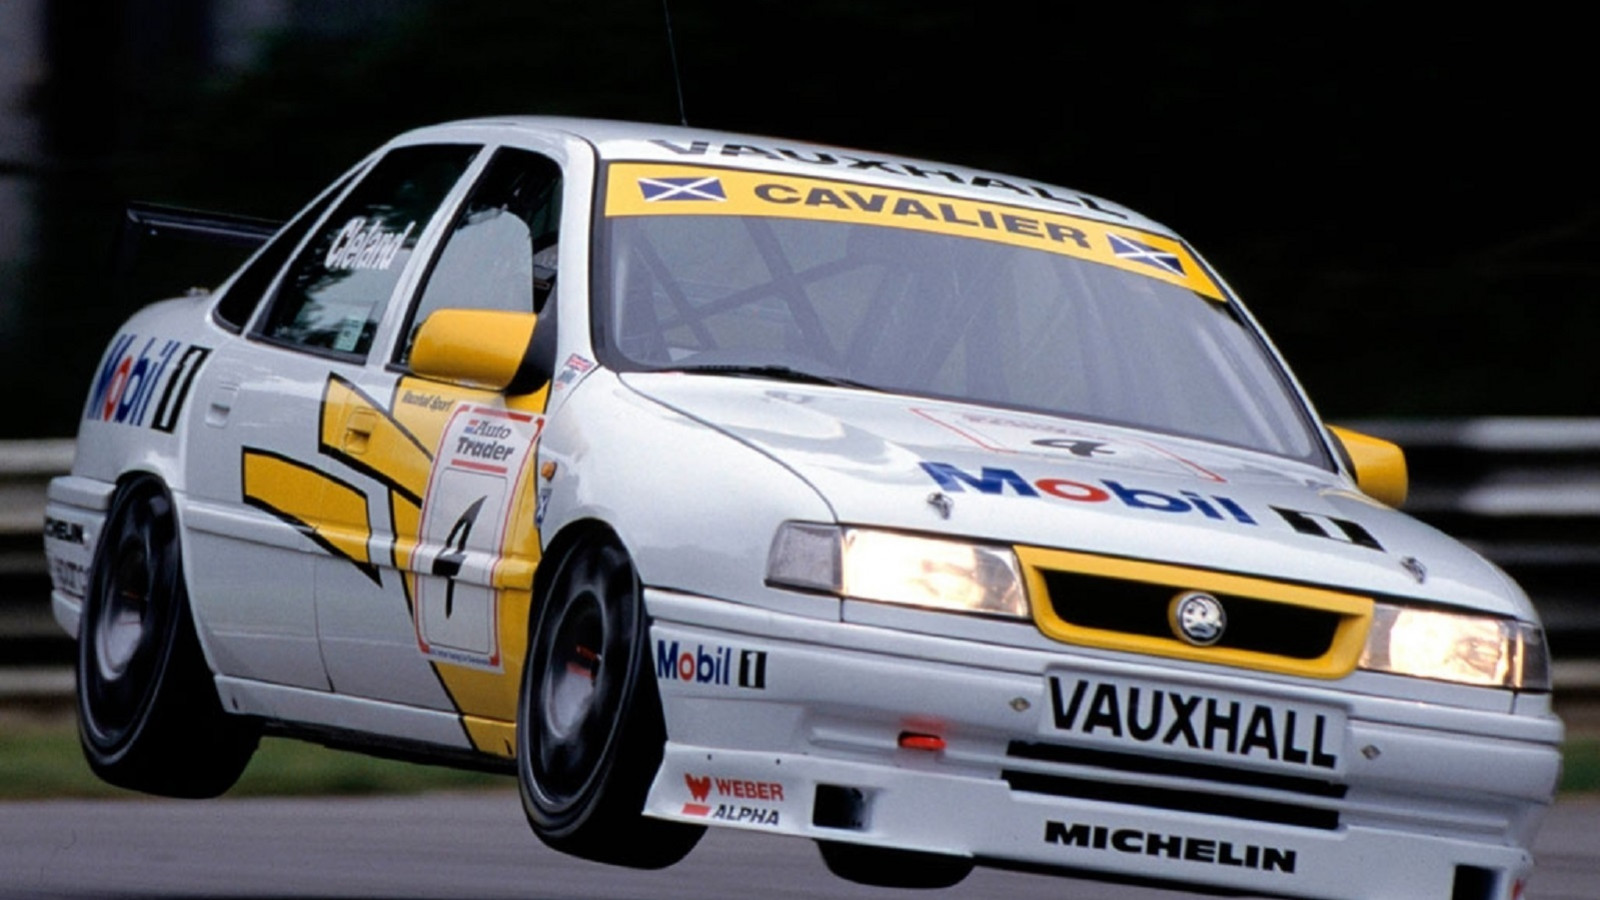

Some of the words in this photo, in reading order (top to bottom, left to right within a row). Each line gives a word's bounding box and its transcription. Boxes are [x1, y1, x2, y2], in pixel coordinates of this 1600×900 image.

[646, 138, 1129, 220] VAUXHALL
[754, 182, 1092, 249] CAVALIER
[324, 216, 416, 270] Cleland
[87, 334, 182, 427] Mobil
[151, 344, 215, 434] 1
[455, 437, 515, 461] Trader
[472, 420, 512, 439] Auto
[1031, 438, 1115, 457] 4
[919, 461, 1258, 526] Mobil
[432, 495, 488, 619] 4
[657, 639, 732, 686] Mobil
[738, 648, 767, 690] 1
[1049, 676, 1337, 769] VAUXHALL
[712, 804, 780, 825] ALPHA
[714, 777, 784, 801] WEBER
[1044, 820, 1297, 874] MICHELIN
